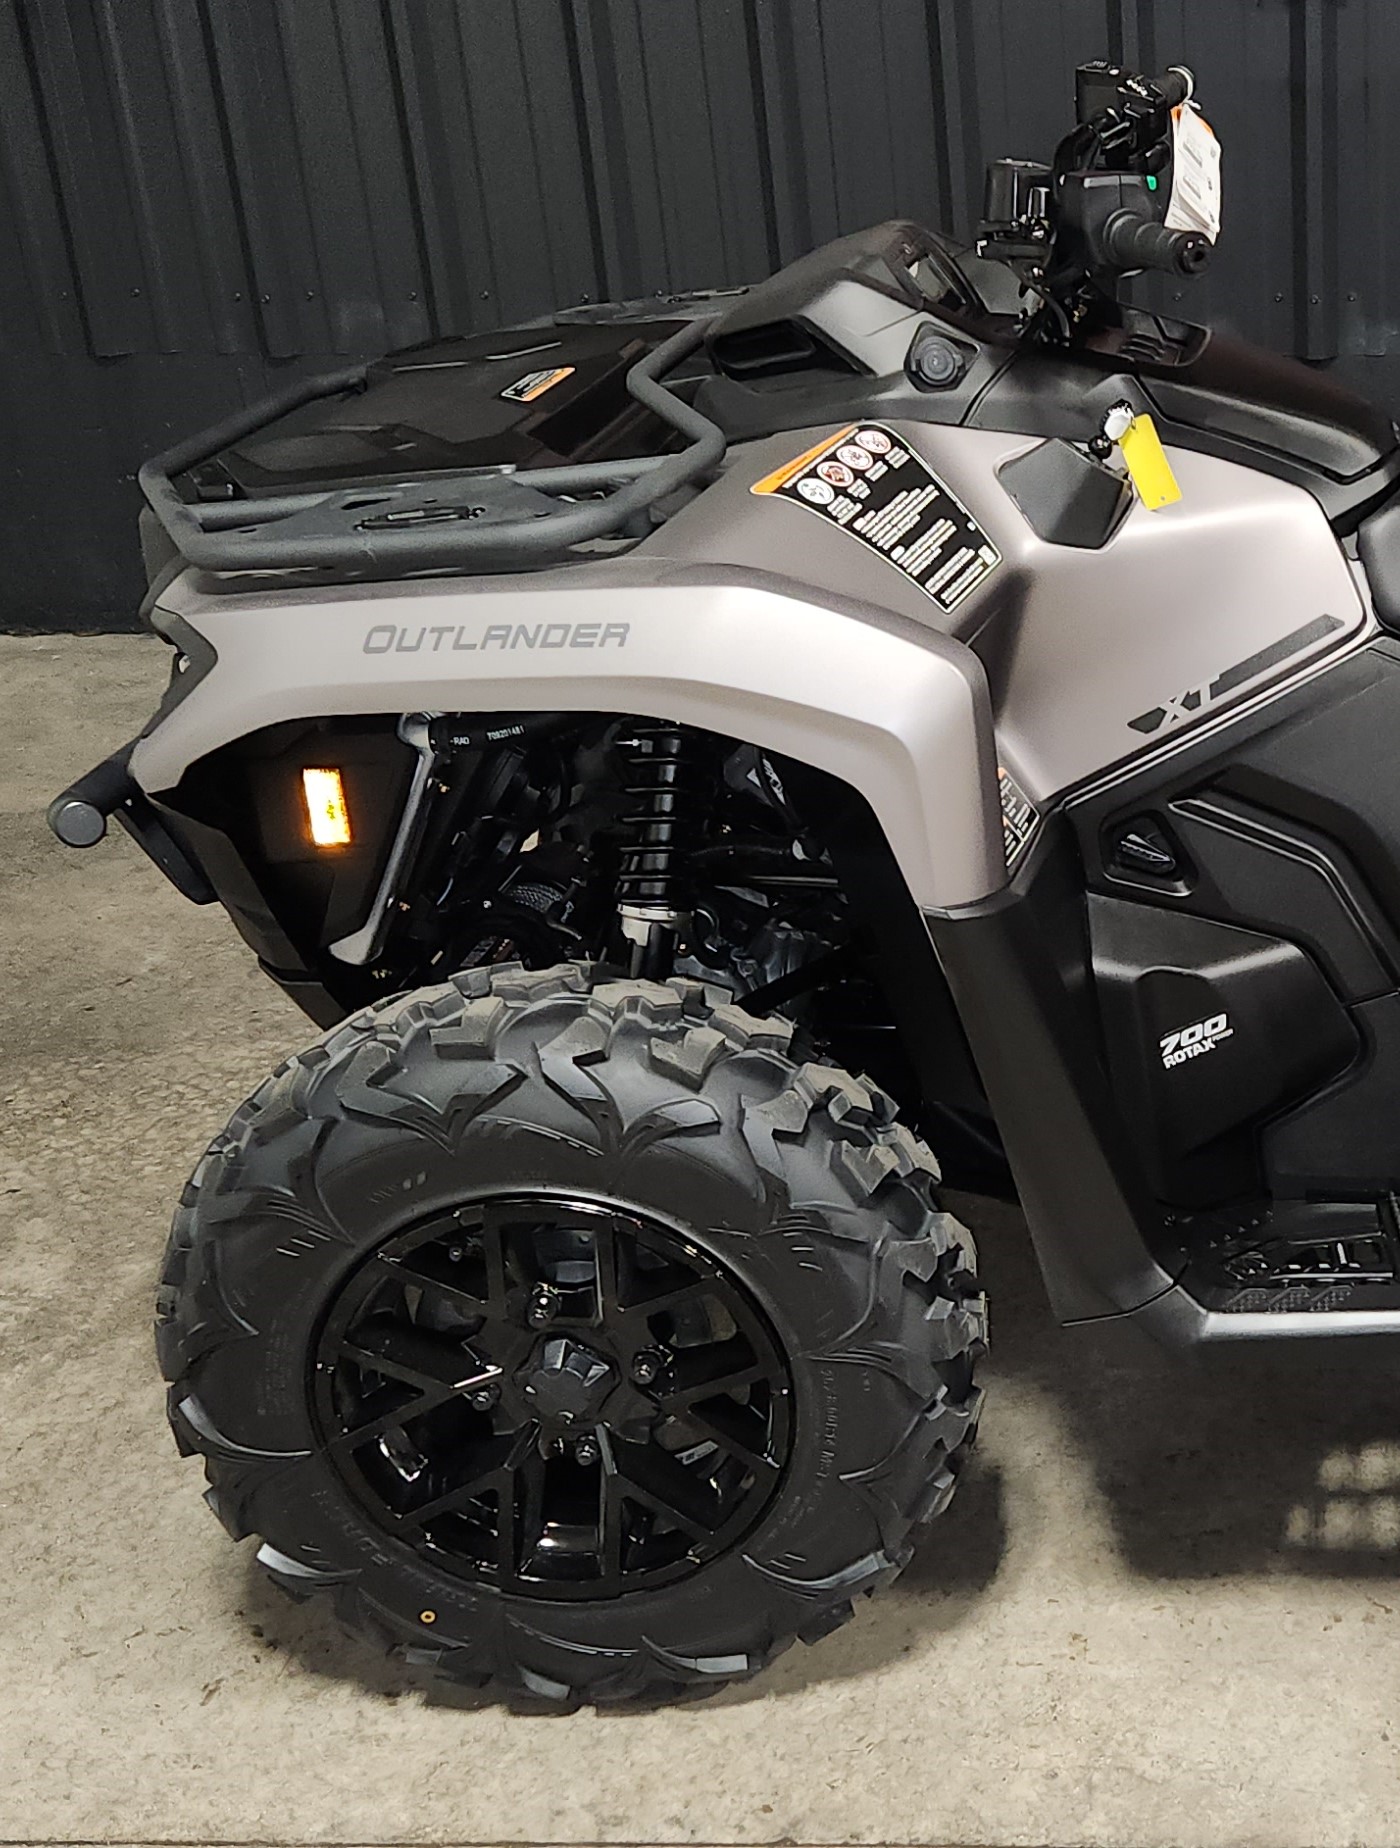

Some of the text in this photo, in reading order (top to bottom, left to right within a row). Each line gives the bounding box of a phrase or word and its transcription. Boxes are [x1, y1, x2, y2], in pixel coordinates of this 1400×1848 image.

[362, 623, 630, 654] OUTLANDER
[1160, 1013, 1227, 1058] 700
[1162, 1037, 1216, 1070] ROTAX
